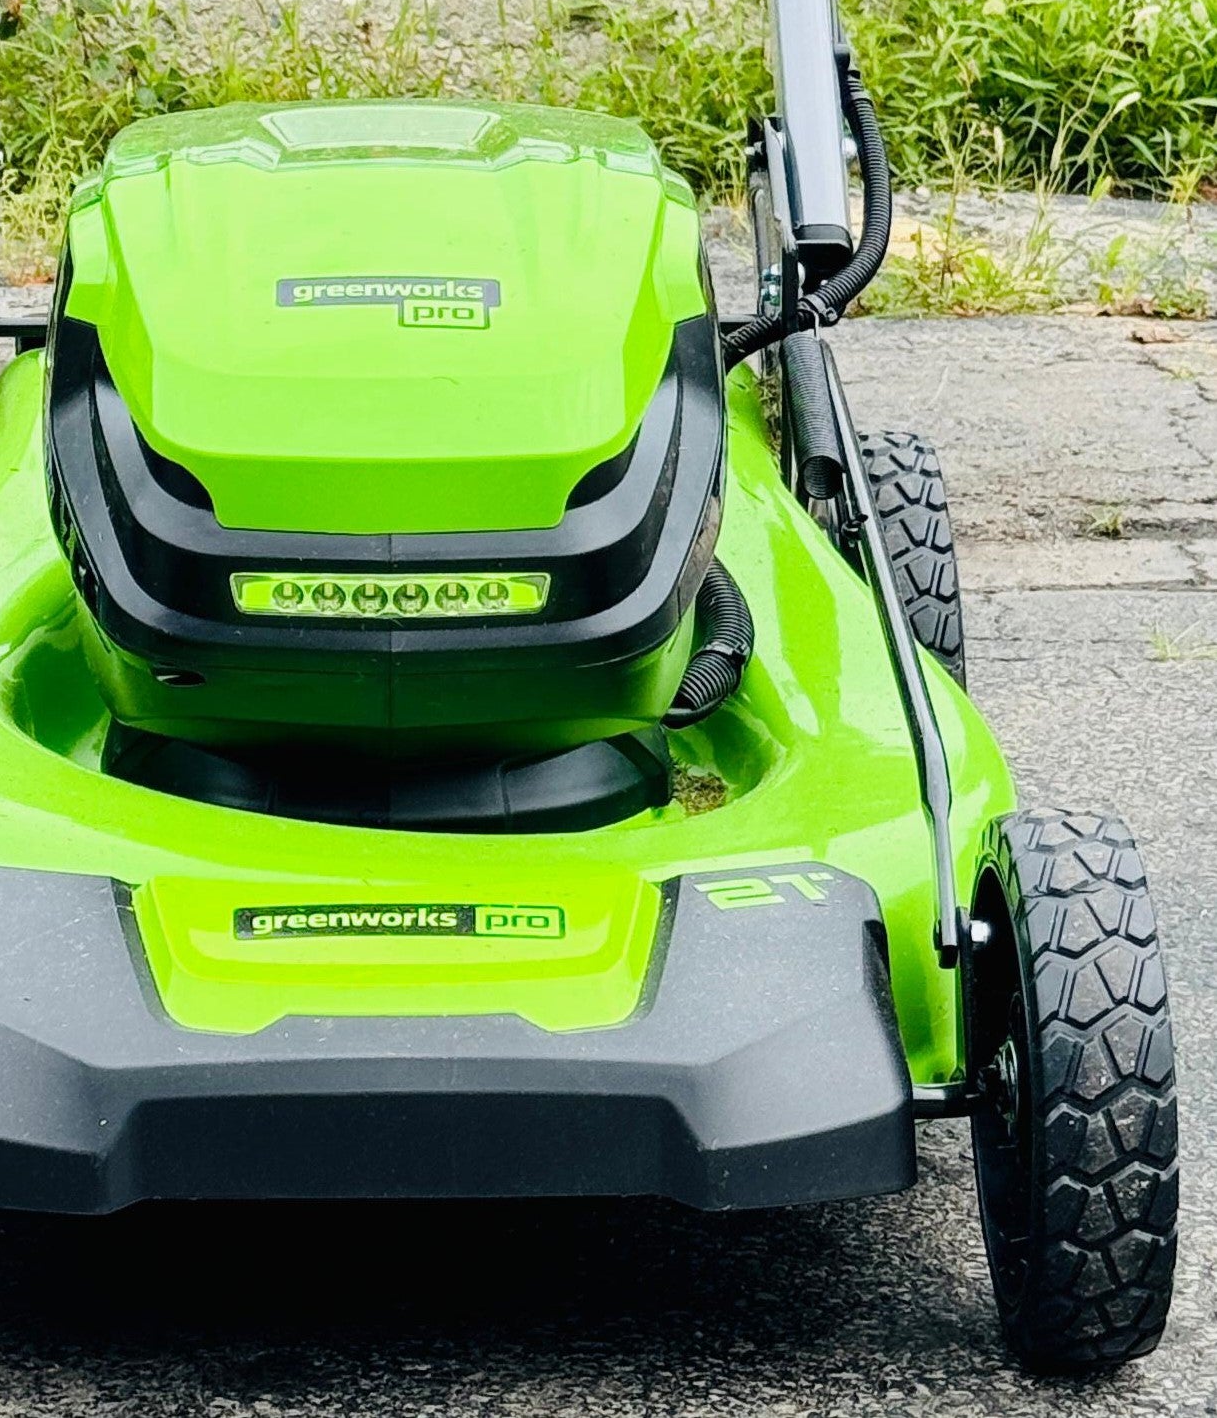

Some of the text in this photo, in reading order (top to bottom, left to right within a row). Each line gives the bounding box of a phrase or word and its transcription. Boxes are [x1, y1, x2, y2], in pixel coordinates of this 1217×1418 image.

[293, 280, 484, 303] greenworks
[412, 305, 475, 322] pro
[251, 907, 550, 935] greenworks pro
